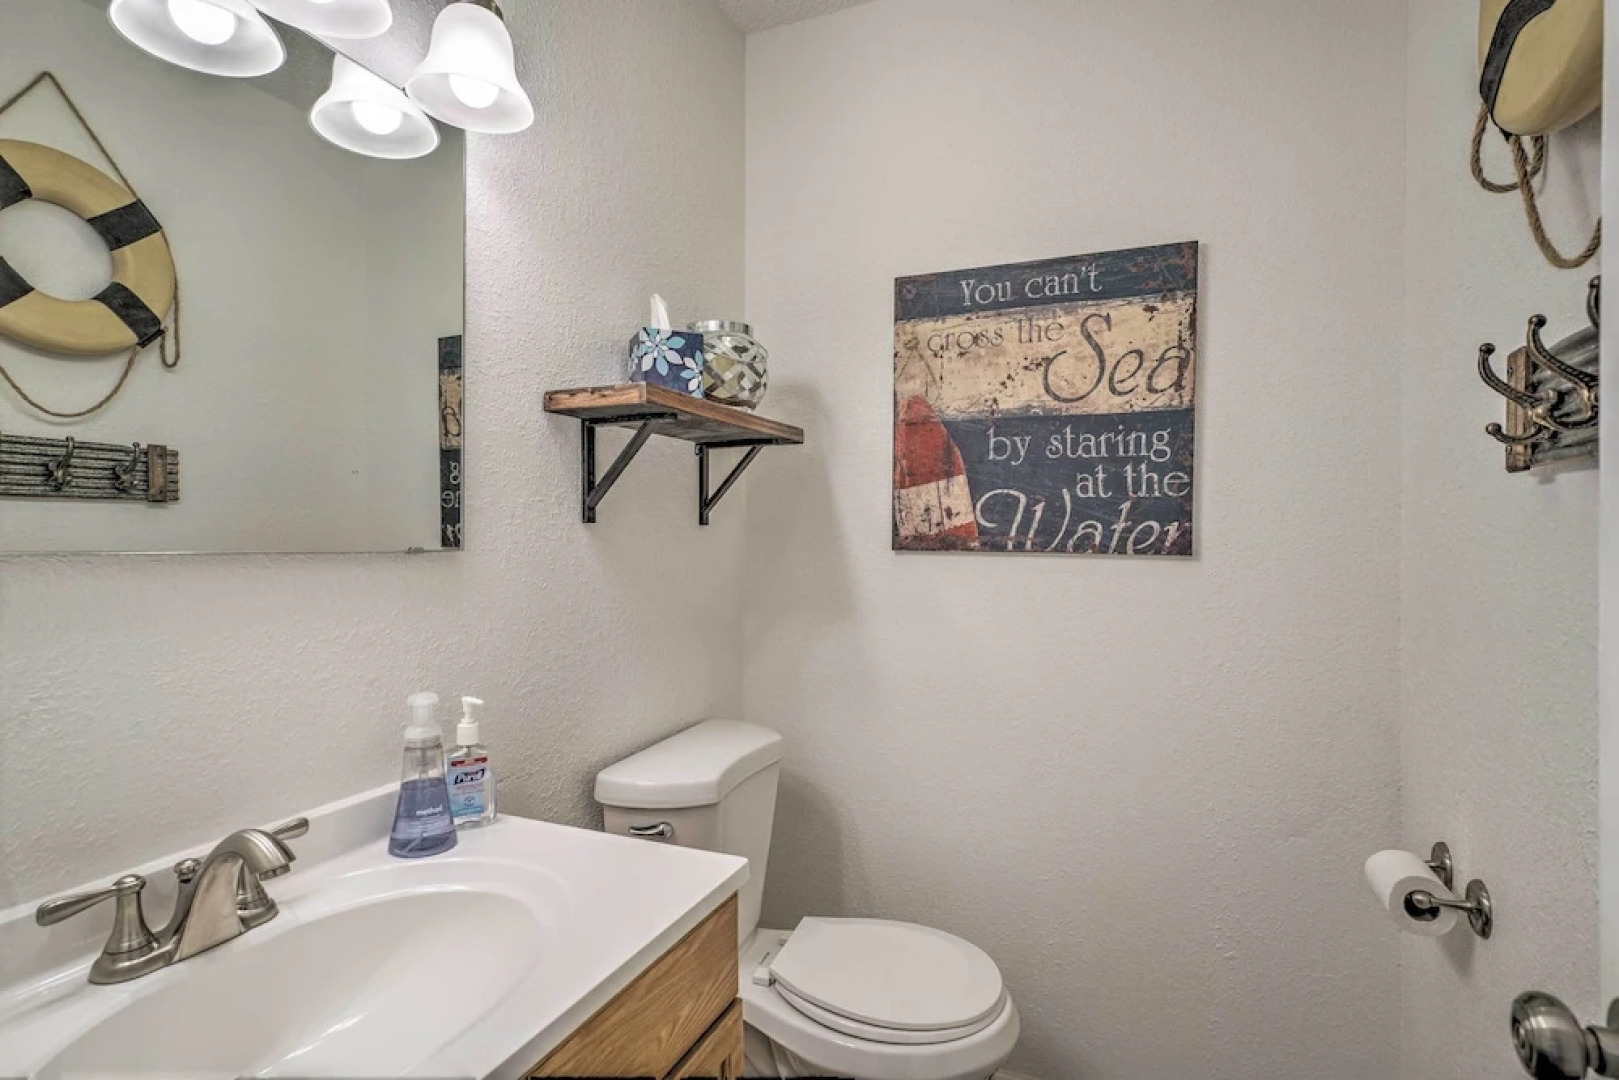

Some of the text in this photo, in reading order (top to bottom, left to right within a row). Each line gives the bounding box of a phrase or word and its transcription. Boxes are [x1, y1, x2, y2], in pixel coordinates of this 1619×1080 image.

[960, 263, 1103, 306] You can't
[926, 317, 1065, 353] cross the
[1042, 312, 1192, 403] Sea
[986, 425, 1172, 466] by staring
[1075, 460, 1191, 498] at the
[975, 488, 1191, 554] Water
